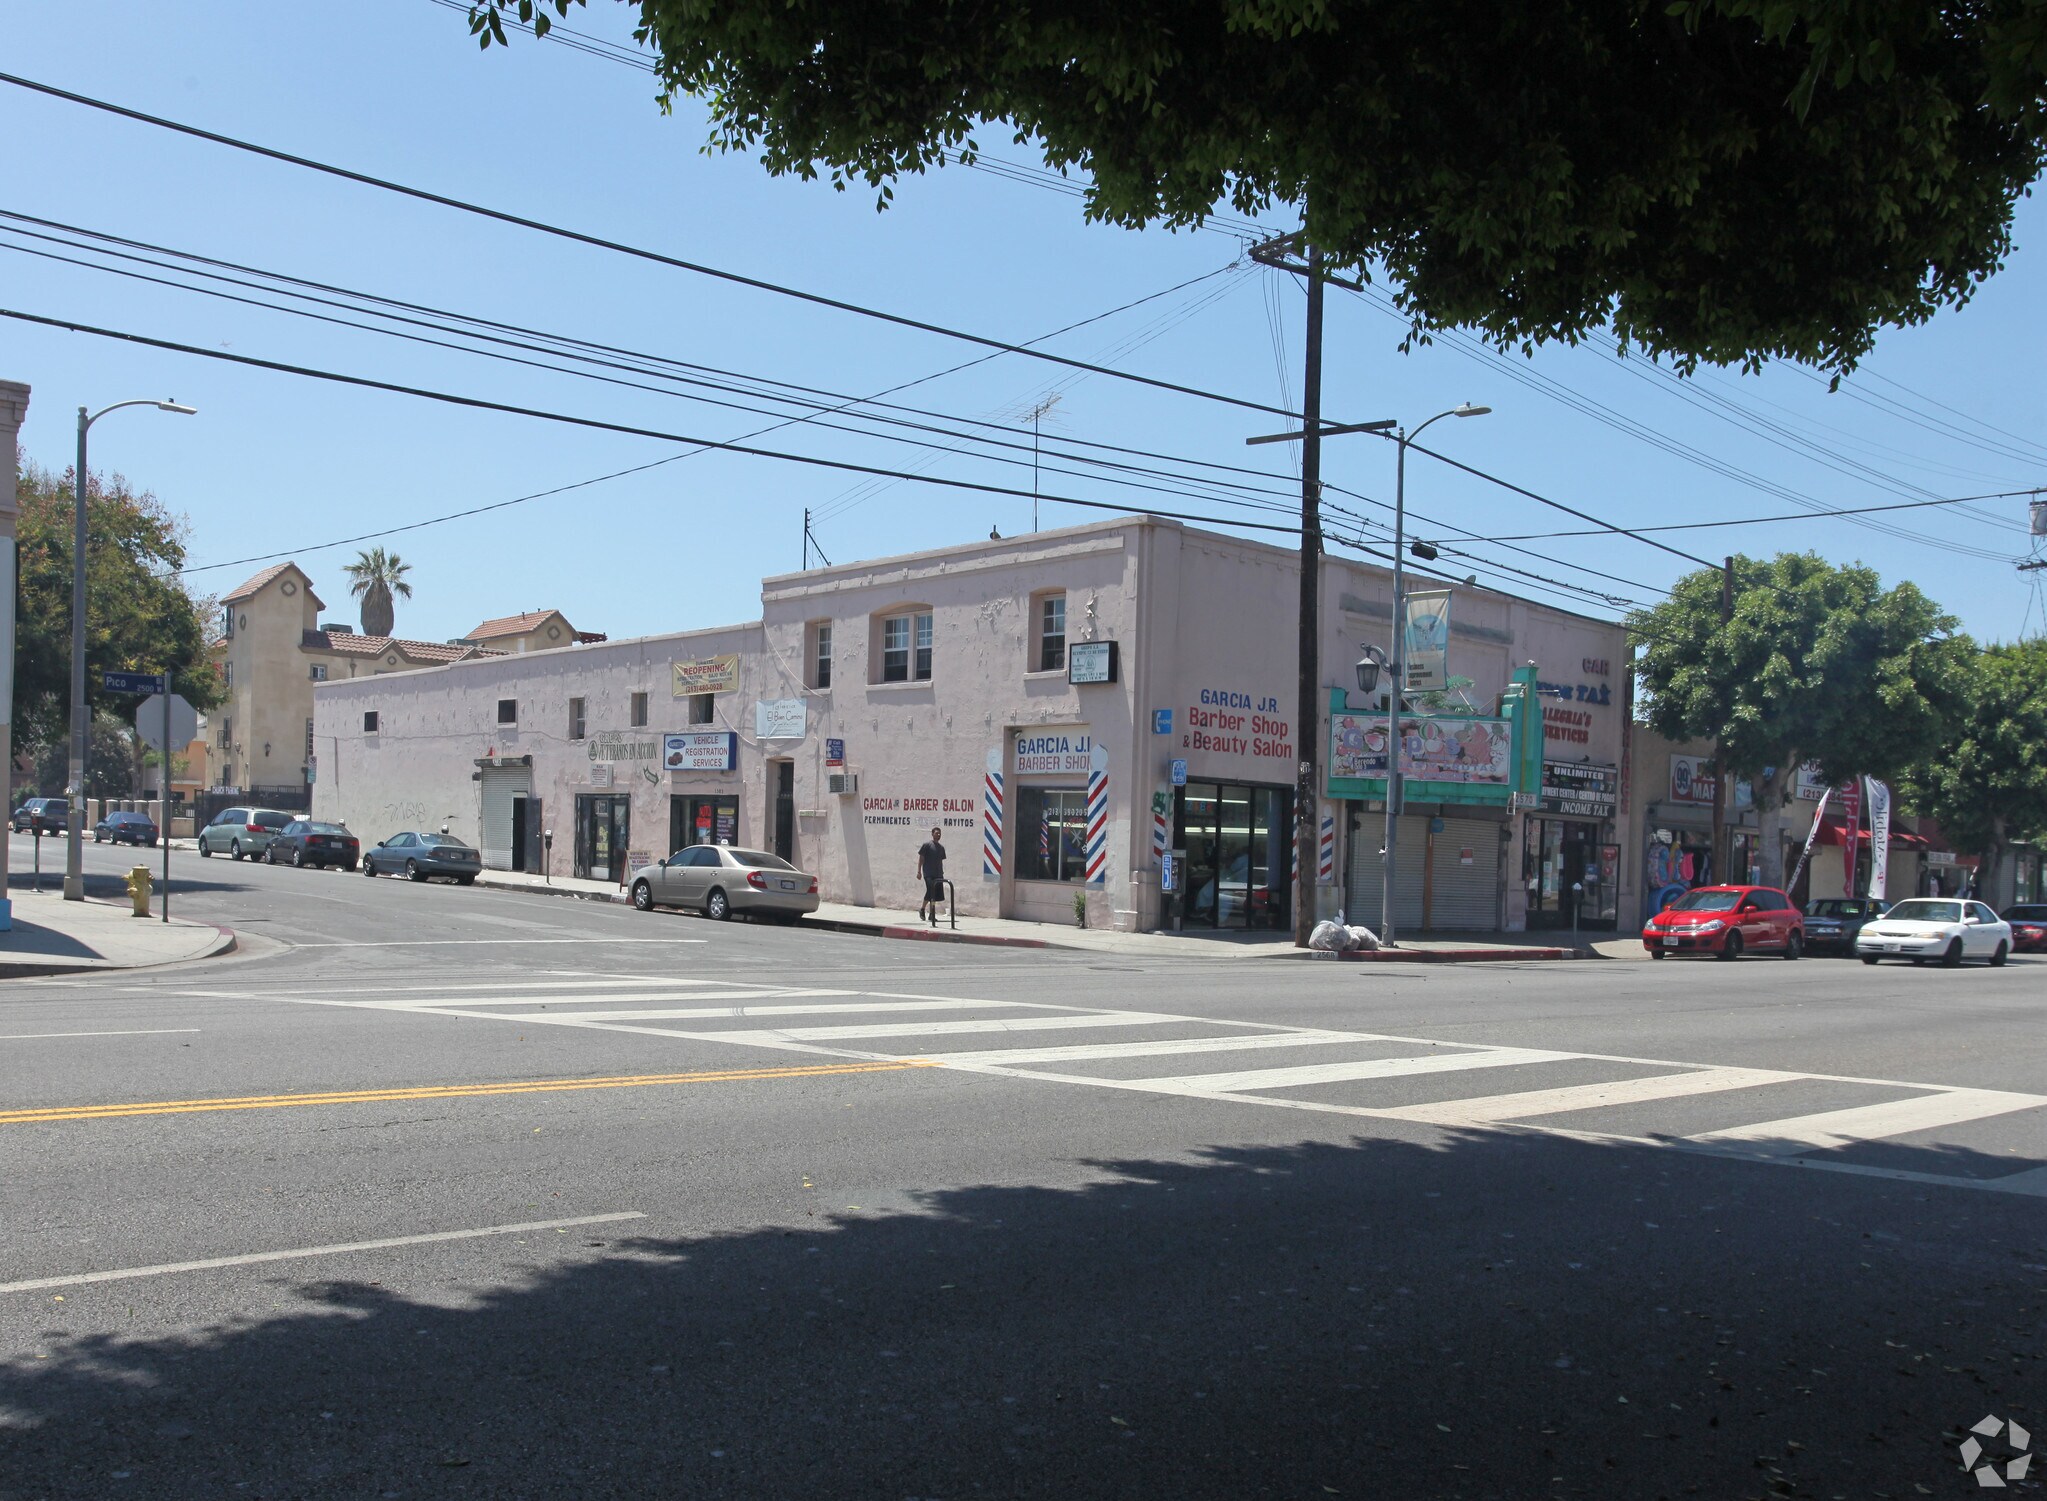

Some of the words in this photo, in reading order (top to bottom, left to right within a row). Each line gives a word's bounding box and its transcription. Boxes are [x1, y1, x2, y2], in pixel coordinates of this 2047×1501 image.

[684, 663, 726, 676] REOPENING
[106, 676, 126, 687] Pico
[1200, 688, 1251, 710] GARCIA
[1257, 697, 1280, 713] J.R.
[1189, 706, 1245, 731] Barber
[1252, 715, 1288, 740] Shop
[693, 736, 719, 745] VEHICLE
[1017, 737, 1069, 755] GARCIA
[1183, 734, 1190, 748] &
[1193, 730, 1247, 756] Beauty
[1253, 737, 1292, 759] Salon
[598, 743, 628, 761] VETERANOS
[685, 747, 728, 757] REGISTRATION
[692, 758, 723, 767] SERVICES
[1018, 756, 1060, 771] BARBER
[1554, 766, 1604, 780] UNLIMITED
[1676, 767, 1689, 790] 99
[864, 798, 893, 811] GARCIA
[903, 799, 939, 811] BARBER
[942, 800, 974, 812] SALON
[1560, 802, 1592, 816] INCOME
[1593, 805, 1610, 816] TAX
[864, 816, 911, 825] PERMANENTES
[943, 818, 974, 827] RAYITOS
